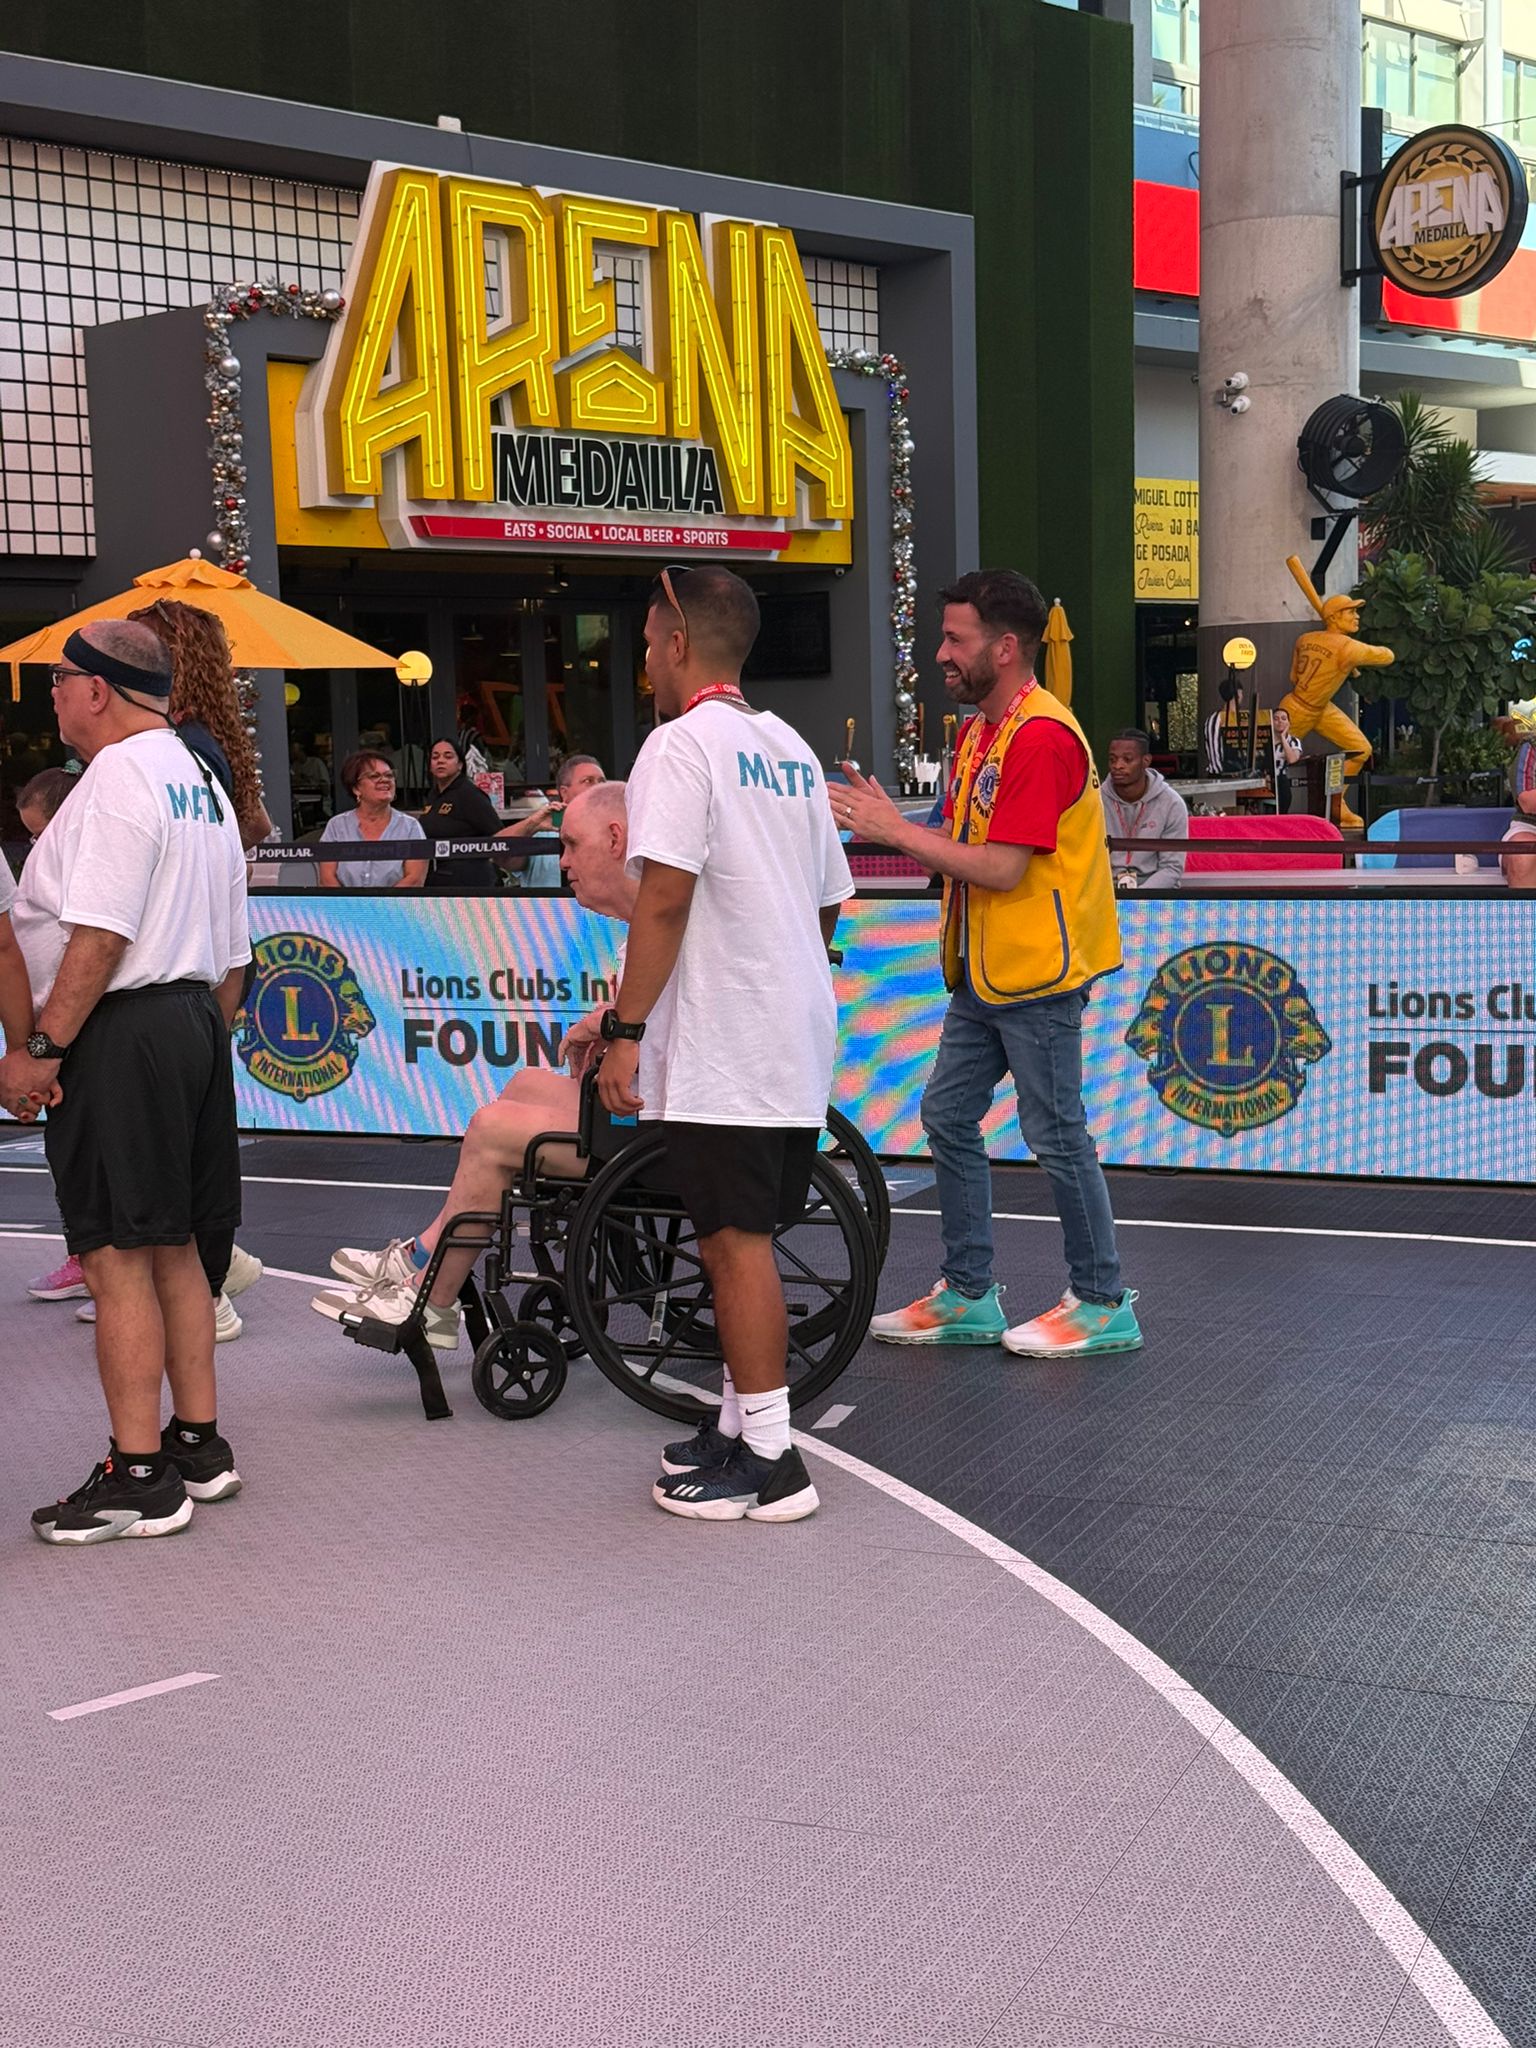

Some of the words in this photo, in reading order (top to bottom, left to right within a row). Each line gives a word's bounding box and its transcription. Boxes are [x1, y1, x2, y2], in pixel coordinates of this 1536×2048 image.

[1380, 171, 1504, 250] ARENA
[1415, 223, 1468, 244] MEDALLA
[325, 168, 854, 521] ARENA
[494, 432, 726, 515] MEDALLA
[1134, 488, 1170, 507] MIGUEL
[504, 522, 536, 538] EATS
[546, 523, 593, 540] SOCIAL
[602, 526, 642, 542] LOCAL
[643, 528, 673, 543] BEER
[683, 530, 729, 545] SPORTS
[1136, 544, 1148, 560] GE
[1152, 544, 1190, 562] POSADA
[737, 751, 815, 798] MATP
[259, 848, 311, 858] POPULAR
[452, 842, 507, 853] POPULAR
[401, 967, 481, 1000] Lions
[489, 969, 572, 1002] Clubs
[1170, 950, 1283, 990] LIONS
[279, 986, 320, 1041] L
[1369, 981, 1475, 1020] Lions
[403, 1019, 577, 1067] FOUN
[1206, 1003, 1256, 1067] L
[256, 1056, 343, 1087] INTERNATIONAL
[1369, 1040, 1536, 1099] FOU
[1170, 1085, 1285, 1119] INTERNATIONAL
